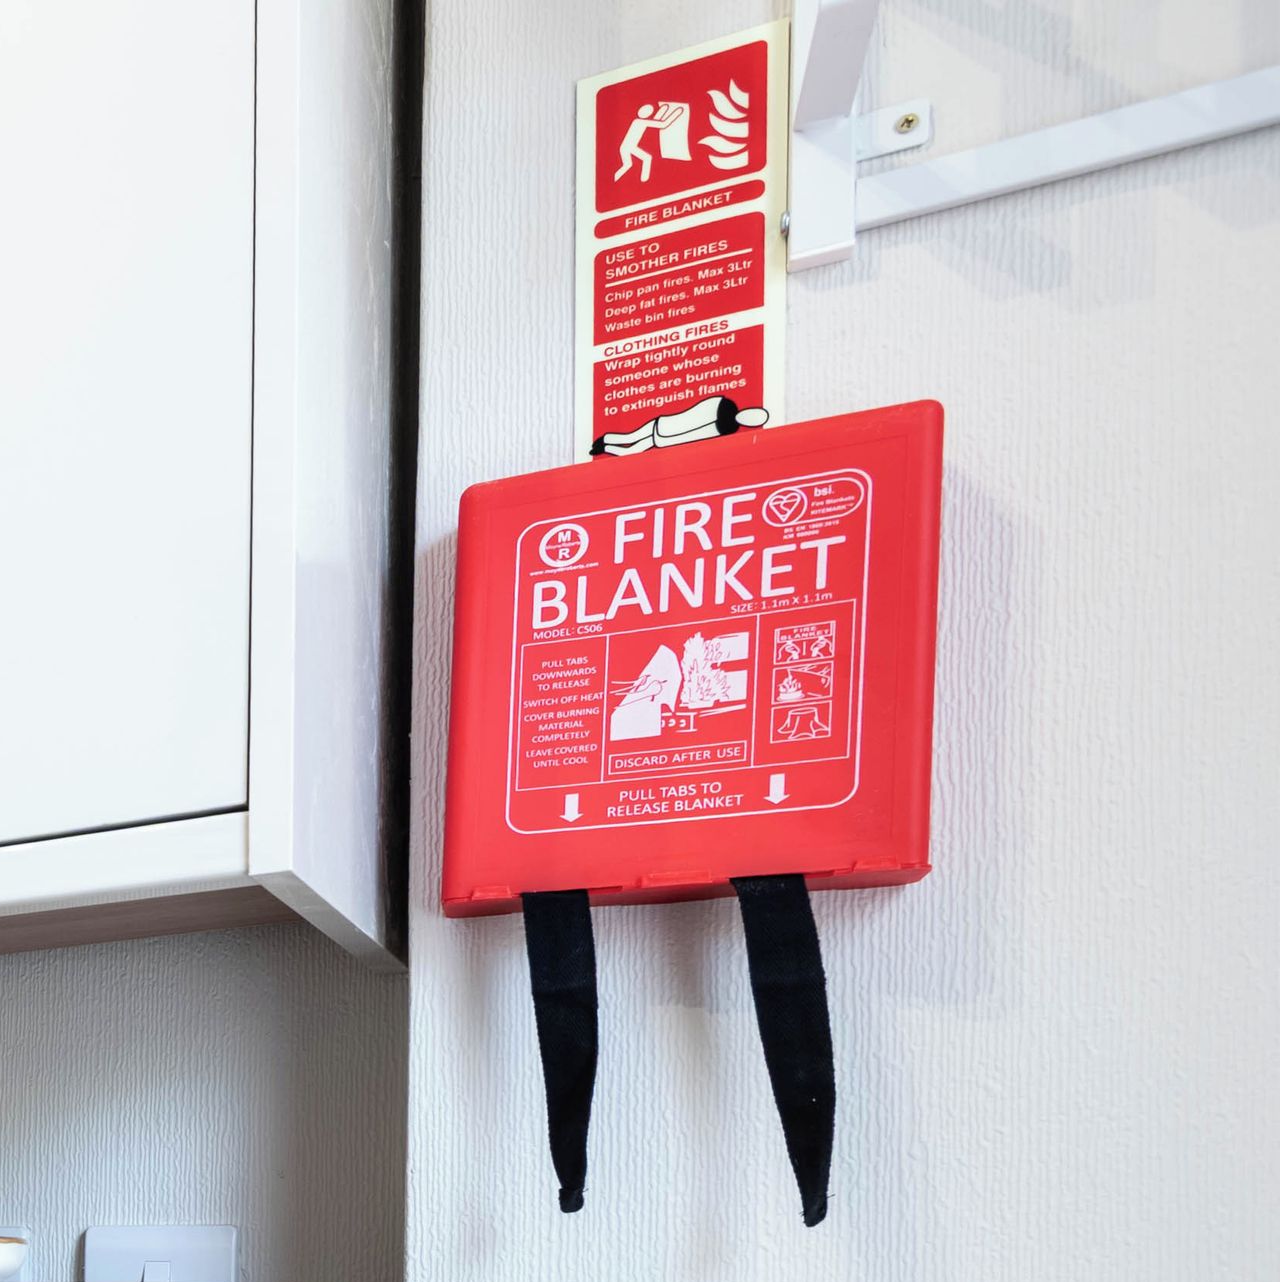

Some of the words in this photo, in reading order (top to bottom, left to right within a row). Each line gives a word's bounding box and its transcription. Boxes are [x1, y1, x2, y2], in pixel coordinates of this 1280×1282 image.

[624, 211, 658, 228] FIRE
[662, 191, 733, 219] BLANKET
[605, 253, 679, 280] SMOTHER
[684, 240, 728, 260] FIRES
[606, 250, 634, 265] USE
[641, 242, 660, 255] TO
[605, 287, 633, 303] Chip
[637, 283, 659, 298] pan
[663, 274, 693, 290] fires.
[698, 267, 723, 280] Max
[728, 258, 752, 272] 3Ltr
[605, 302, 636, 318] Deep
[640, 298, 655, 310] fat
[659, 290, 689, 305] fires.
[694, 284, 719, 297] Max
[723, 275, 748, 289] 3Ltr
[605, 317, 641, 333] Waste
[645, 311, 664, 324] bin
[668, 304, 695, 318] fires
[604, 331, 680, 357] CLOTHING
[685, 319, 729, 339] FIRES
[605, 356, 640, 372] Wrap
[645, 344, 689, 364] tightly
[692, 334, 735, 351] round
[604, 366, 669, 387] someone
[673, 353, 719, 373] whose
[604, 382, 655, 402] clothes
[659, 377, 681, 390] are
[686, 363, 741, 385] burning
[604, 404, 618, 416] to
[621, 389, 694, 413] extinguish
[698, 378, 746, 397] flames
[558, 531, 571, 543] M
[614, 492, 757, 565] FIRE
[559, 548, 570, 559] R
[532, 535, 847, 630] BLANKET
[730, 602, 758, 614] SIZE:
[761, 598, 789, 610] 1.1m
[803, 592, 833, 604] 1.1m
[533, 626, 575, 640] MODEL:
[577, 623, 603, 635] CS06
[780, 629, 829, 641] BLANKET
[793, 626, 817, 634] FIRE
[541, 660, 563, 669] PULL
[566, 656, 589, 666] TABS
[532, 667, 597, 681] DOWNWARDS
[537, 683, 550, 692] TO
[552, 678, 590, 690] RELEASE
[523, 697, 558, 708] SWITCH
[560, 694, 578, 705] OFF
[580, 691, 604, 702] HEAT
[524, 711, 554, 722] COVER
[557, 706, 600, 719] BURNING
[532, 730, 590, 744] COMPLETELY
[538, 720, 584, 732] MATERIAL
[526, 748, 552, 758] LEAVE
[554, 744, 597, 755] COVERED
[533, 758, 561, 768] UNTIL
[563, 755, 589, 766] COOL
[614, 754, 668, 769] DISCARD
[672, 749, 711, 763] AFTER
[717, 746, 741, 759] USE
[619, 789, 655, 802] PULL
[660, 784, 697, 798] TABS
[701, 781, 722, 794] TO
[607, 801, 669, 818] RELEASE
[674, 794, 744, 812] BLANKET
